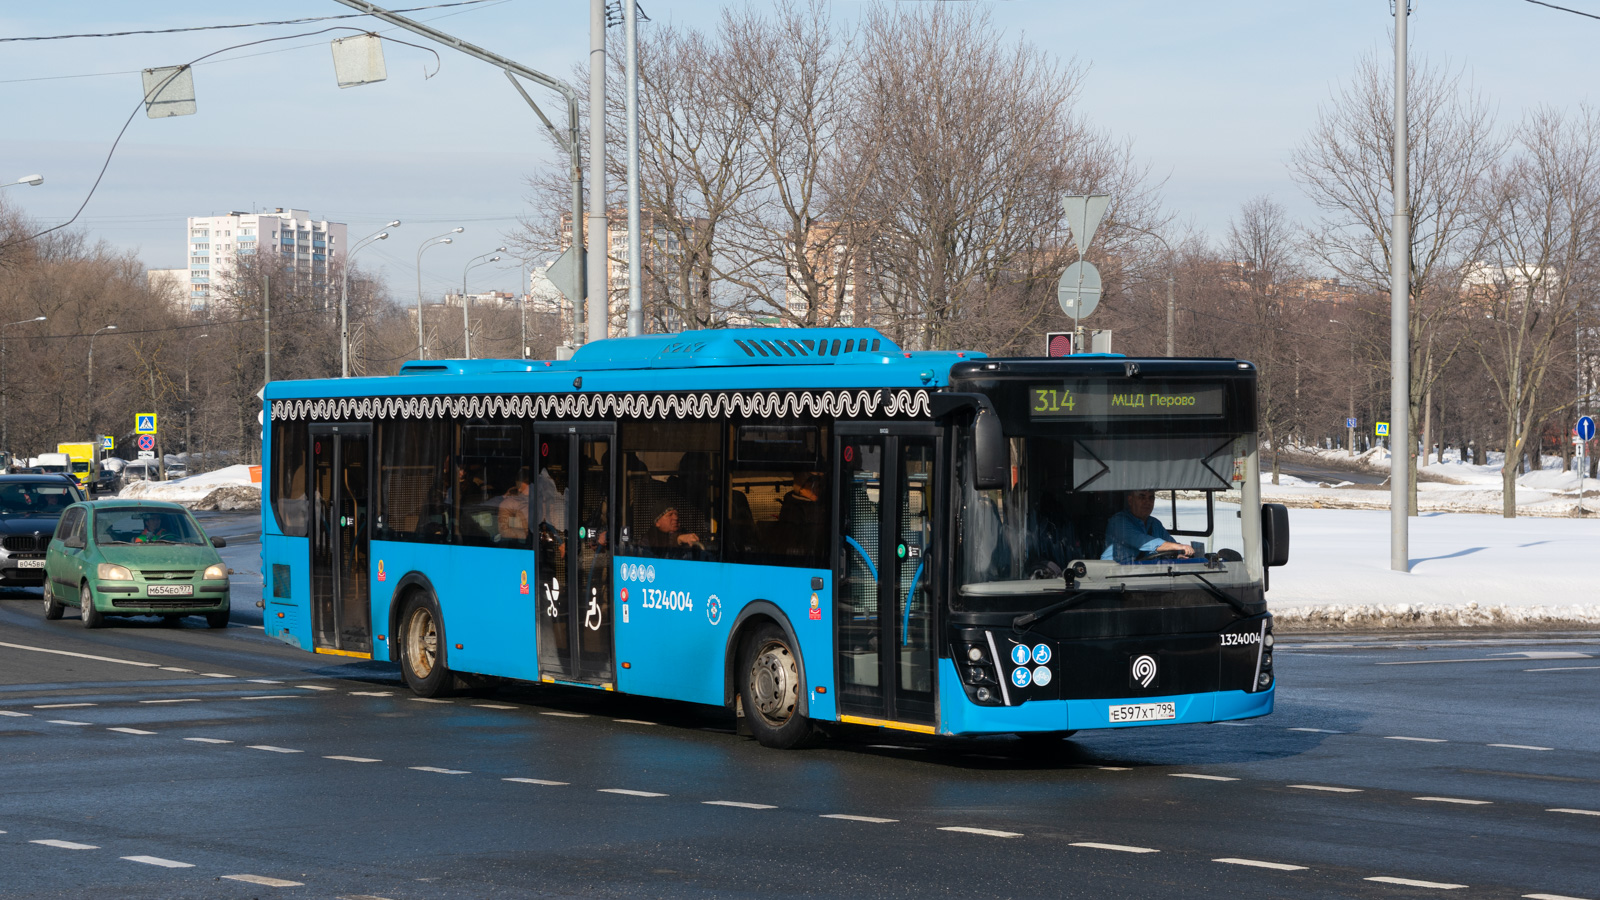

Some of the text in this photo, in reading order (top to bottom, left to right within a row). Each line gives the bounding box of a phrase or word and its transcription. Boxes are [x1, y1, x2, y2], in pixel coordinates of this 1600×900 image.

[1034, 389, 1196, 412] 314 МЦД Перово
[642, 588, 693, 612] 1324004
[1220, 632, 1261, 646] 1324004
[1113, 703, 1172, 720] Е597ХТ 799
